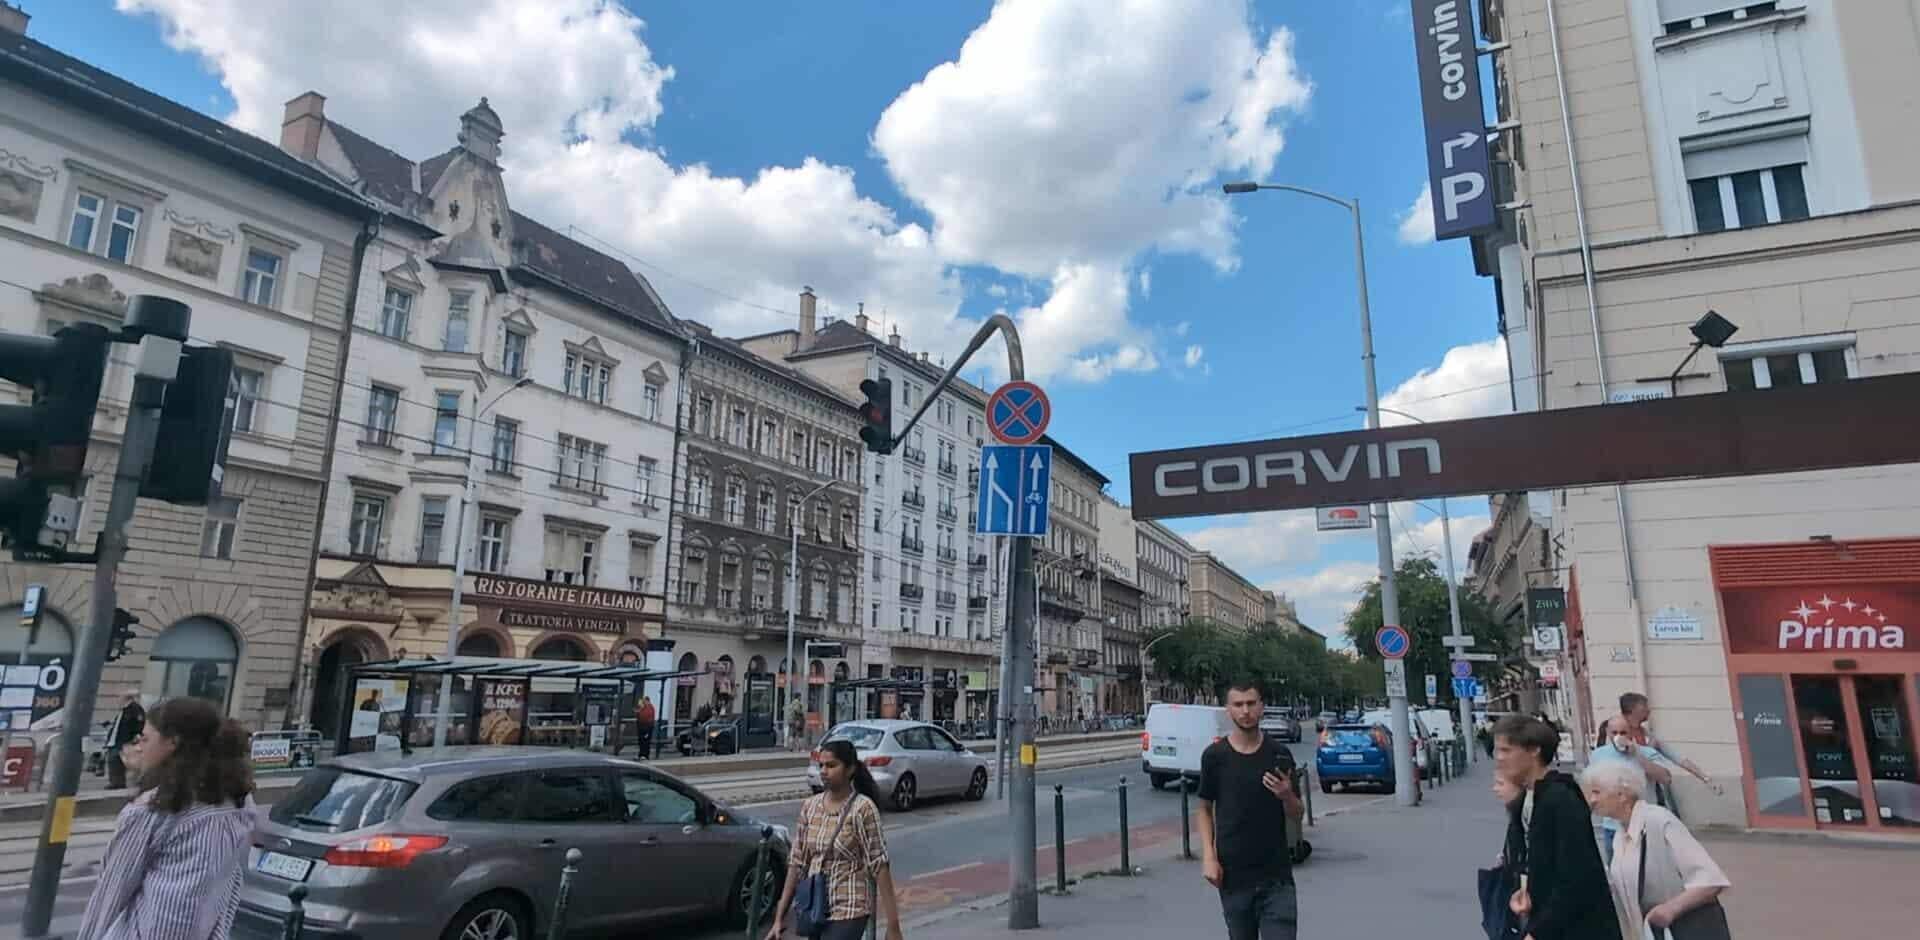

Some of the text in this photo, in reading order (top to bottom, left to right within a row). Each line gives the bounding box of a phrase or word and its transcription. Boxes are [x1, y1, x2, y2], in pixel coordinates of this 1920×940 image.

[1428, 0, 1467, 101] corvin
[1440, 171, 1486, 223] P
[477, 577, 644, 610] RISTORANTE ITALIANO
[510, 612, 622, 633] TRATTORIA VENEZIA
[1778, 617, 1904, 649] Príma
[495, 684, 521, 696] KFC
